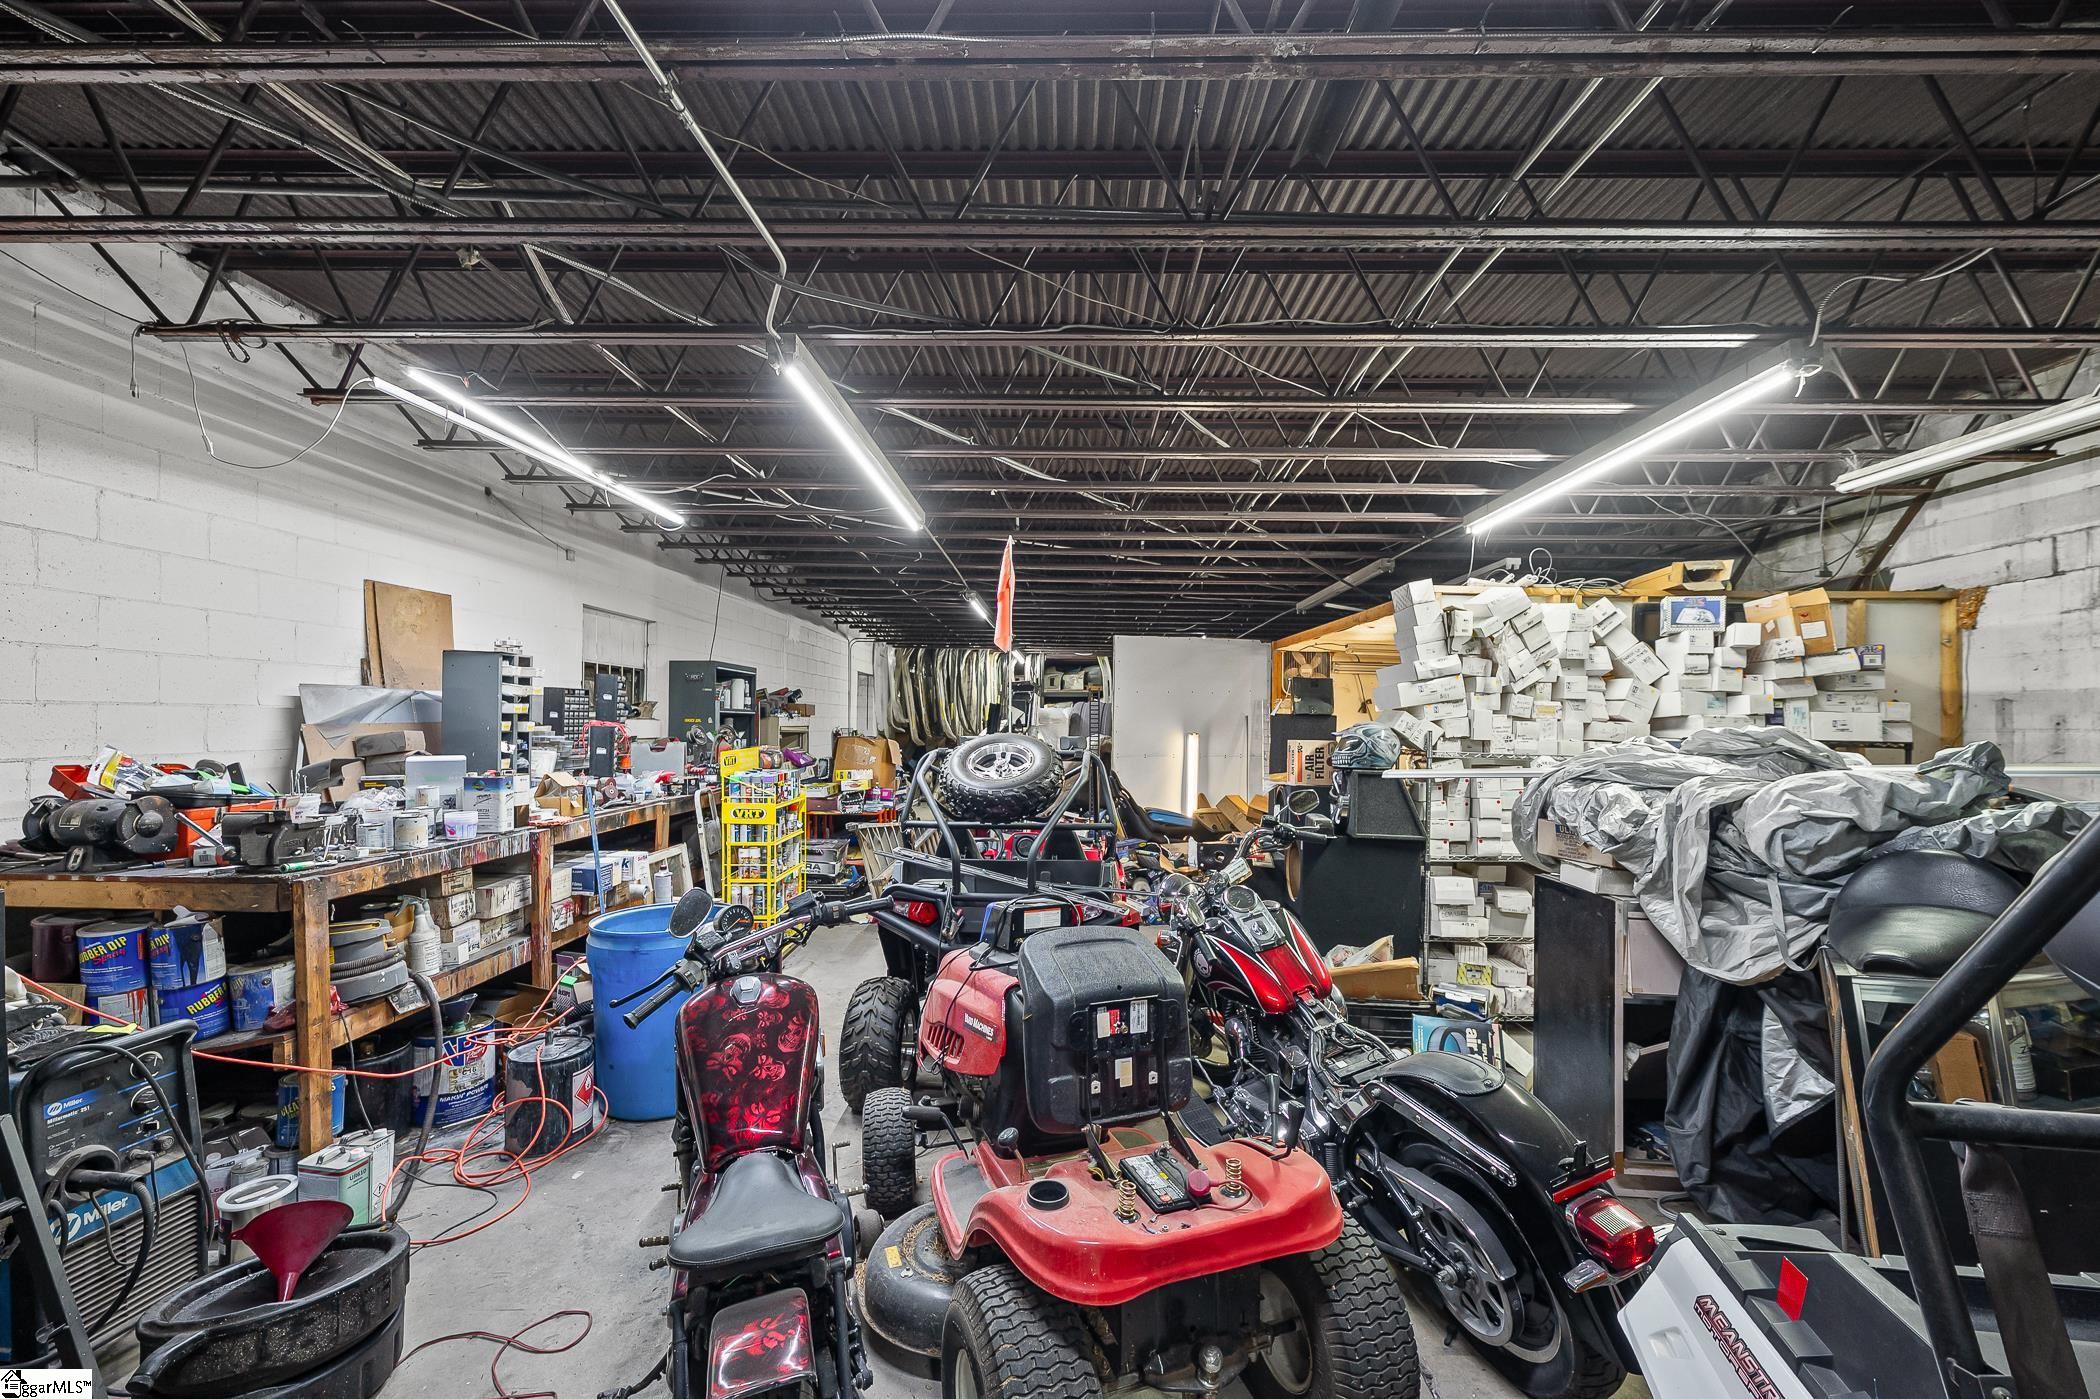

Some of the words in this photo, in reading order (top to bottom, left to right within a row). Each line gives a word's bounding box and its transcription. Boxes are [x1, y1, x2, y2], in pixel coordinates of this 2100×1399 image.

[1305, 754, 1315, 773] AIR
[1315, 746, 1325, 780] FILTER
[734, 809, 764, 820] VHT
[80, 945, 108, 964] UBBER
[106, 936, 127, 952] DIP
[186, 987, 225, 1015] RUBBER
[1465, 1027, 1482, 1052] air
[63, 1098, 83, 1109] Miller
